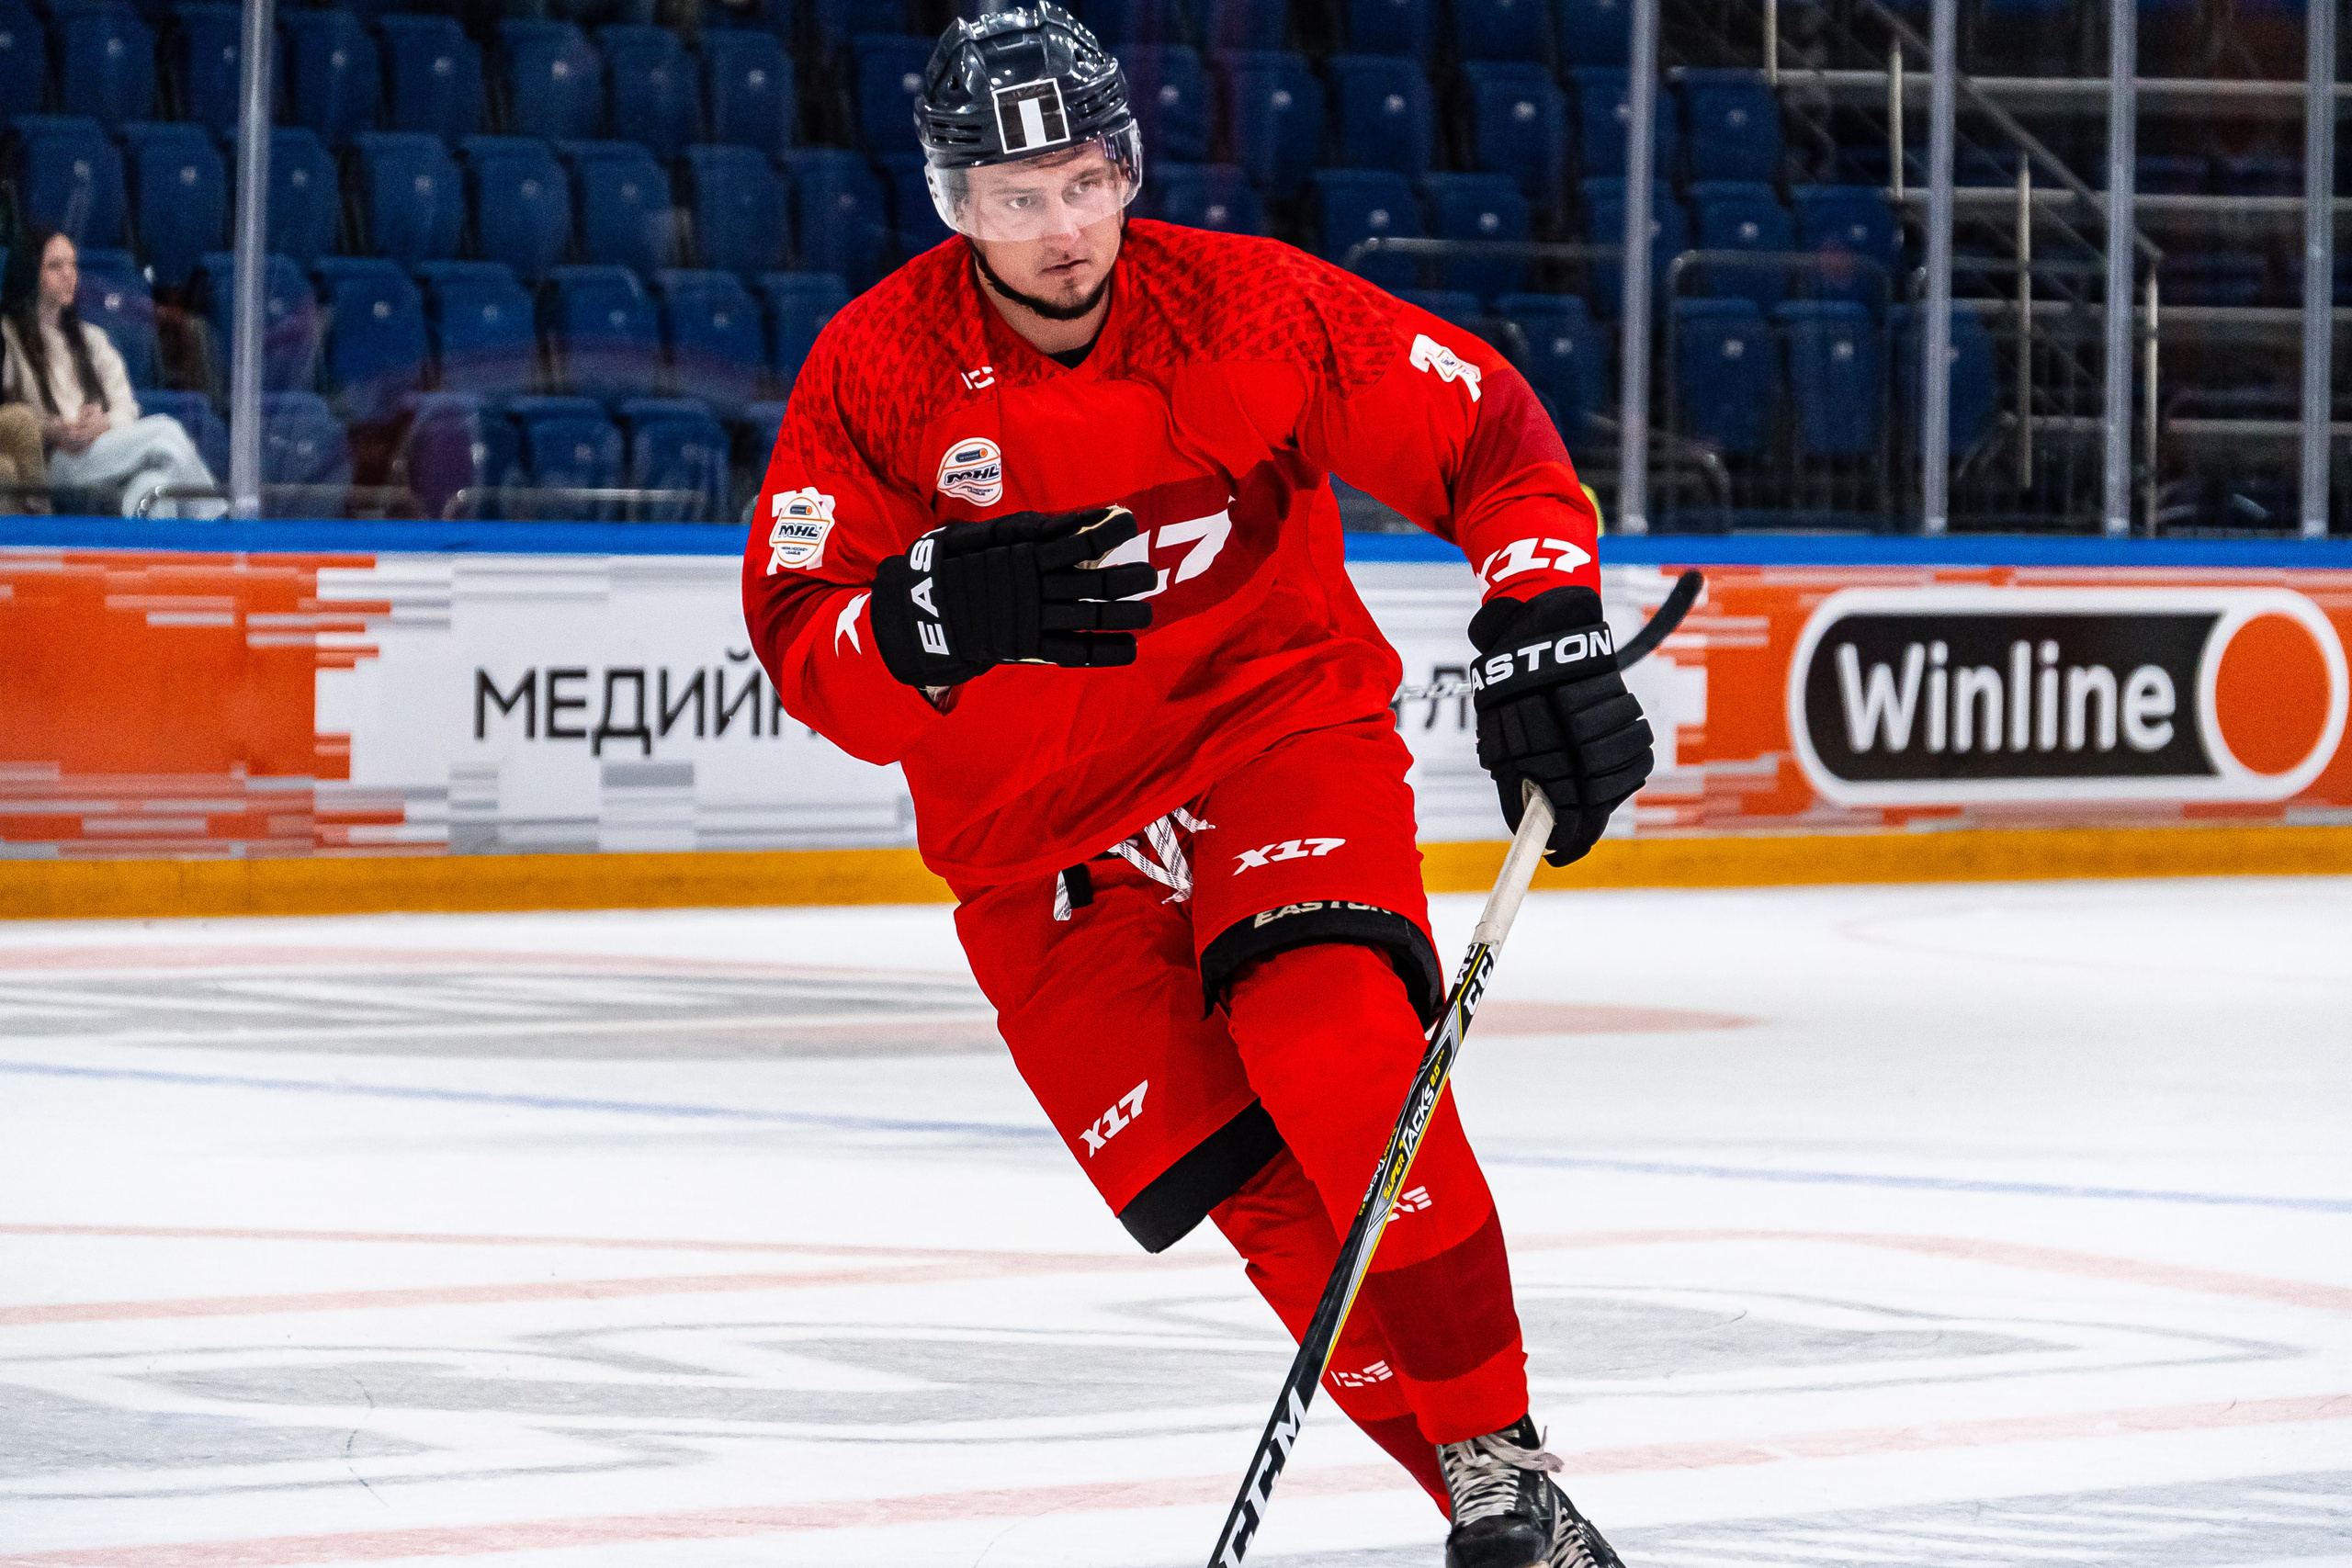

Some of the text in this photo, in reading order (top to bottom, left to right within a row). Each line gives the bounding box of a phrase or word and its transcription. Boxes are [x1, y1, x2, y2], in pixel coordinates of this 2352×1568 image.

[945, 466, 1000, 485] MHL
[777, 523, 820, 539] MHL
[910, 525, 950, 656] EAS
[1471, 628, 1617, 696] ASTON
[1836, 639, 2177, 752] Winline
[1232, 837, 1347, 876] X17
[1464, 946, 1498, 1016] CC
[1078, 1078, 1149, 1158] X17
[1383, 1153, 1406, 1201] SUPER
[1399, 1083, 1435, 1161] TACKS
[1218, 1385, 1307, 1566] CCM
